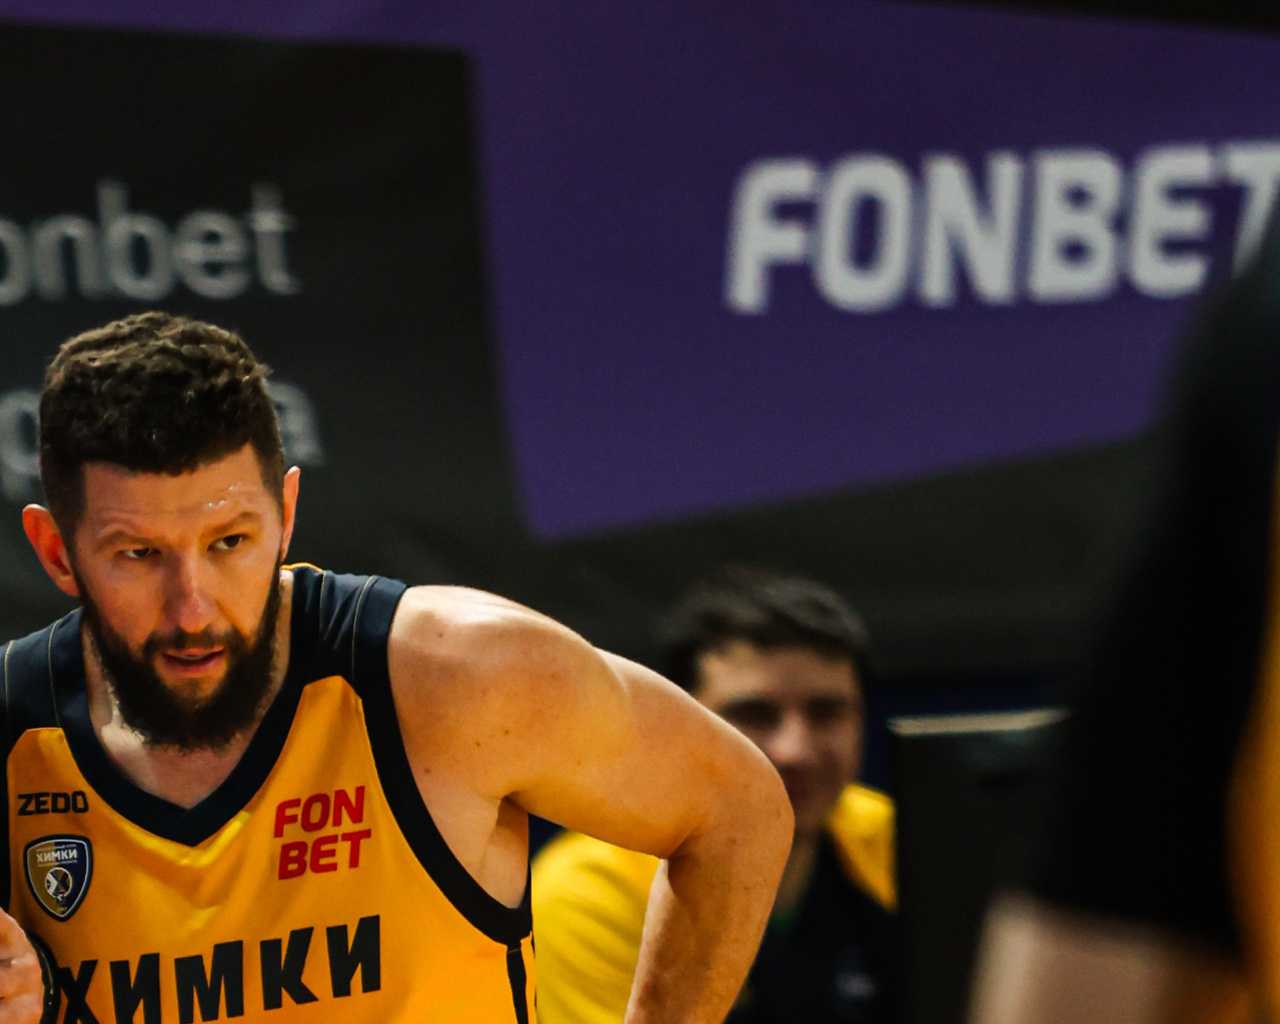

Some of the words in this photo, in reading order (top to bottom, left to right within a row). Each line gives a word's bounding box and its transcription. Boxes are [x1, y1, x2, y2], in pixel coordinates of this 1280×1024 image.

[725, 138, 1280, 316] FONBET
[17, 790, 89, 817] ZEDO
[273, 785, 366, 839] FON
[35, 847, 78, 863] ХИМКИ
[277, 828, 372, 880] BET
